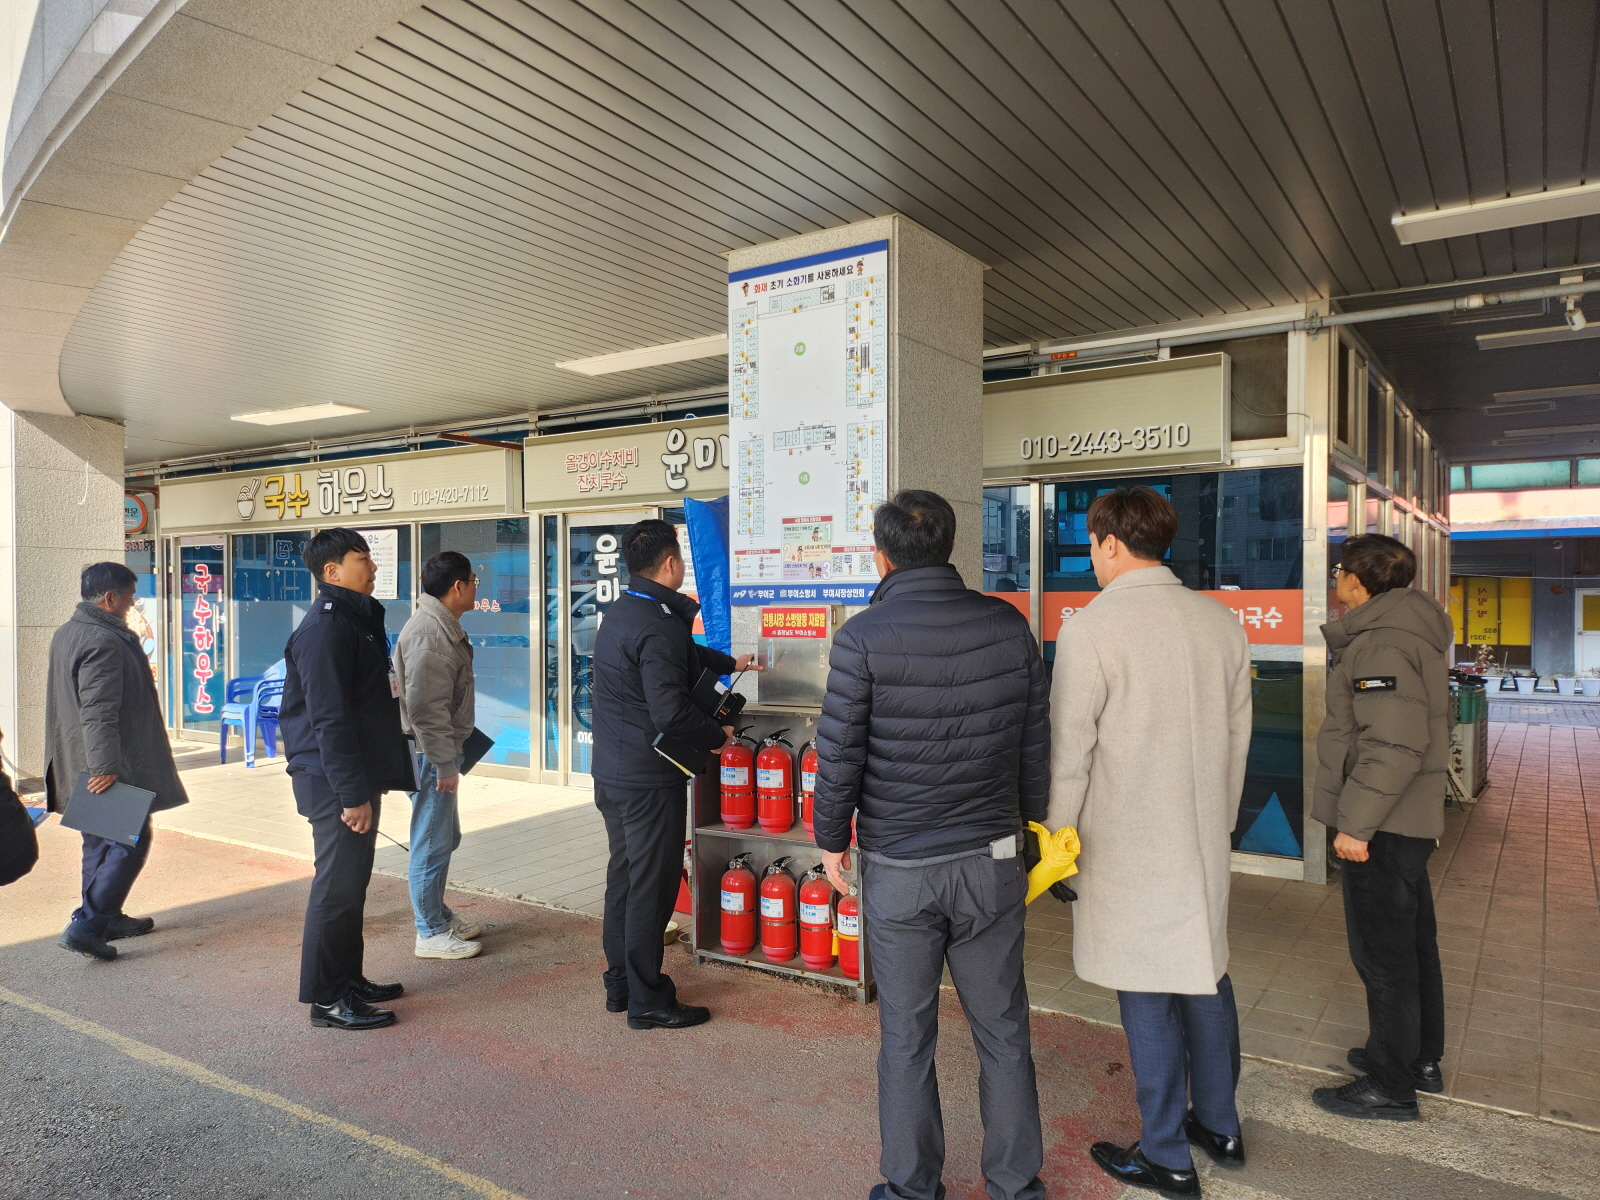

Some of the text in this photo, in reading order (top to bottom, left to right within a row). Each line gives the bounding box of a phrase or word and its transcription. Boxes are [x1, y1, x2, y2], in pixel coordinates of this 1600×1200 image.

[754, 264, 854, 294] 화재 초기 소화기를 사용하세요
[1020, 422, 1190, 459] 010-2443-3510
[565, 446, 639, 473] 올갱이수제비
[264, 465, 394, 519] 국수 하우스
[577, 470, 627, 492] 잔치국수
[412, 485, 489, 506] 010-9420-7112
[824, 523, 832, 542] 1
[783, 543, 792, 561] 2
[823, 561, 832, 580] 3
[757, 588, 865, 599] 부여군 부여소방서 부여시장상인회
[193, 563, 214, 713] 국수하우스
